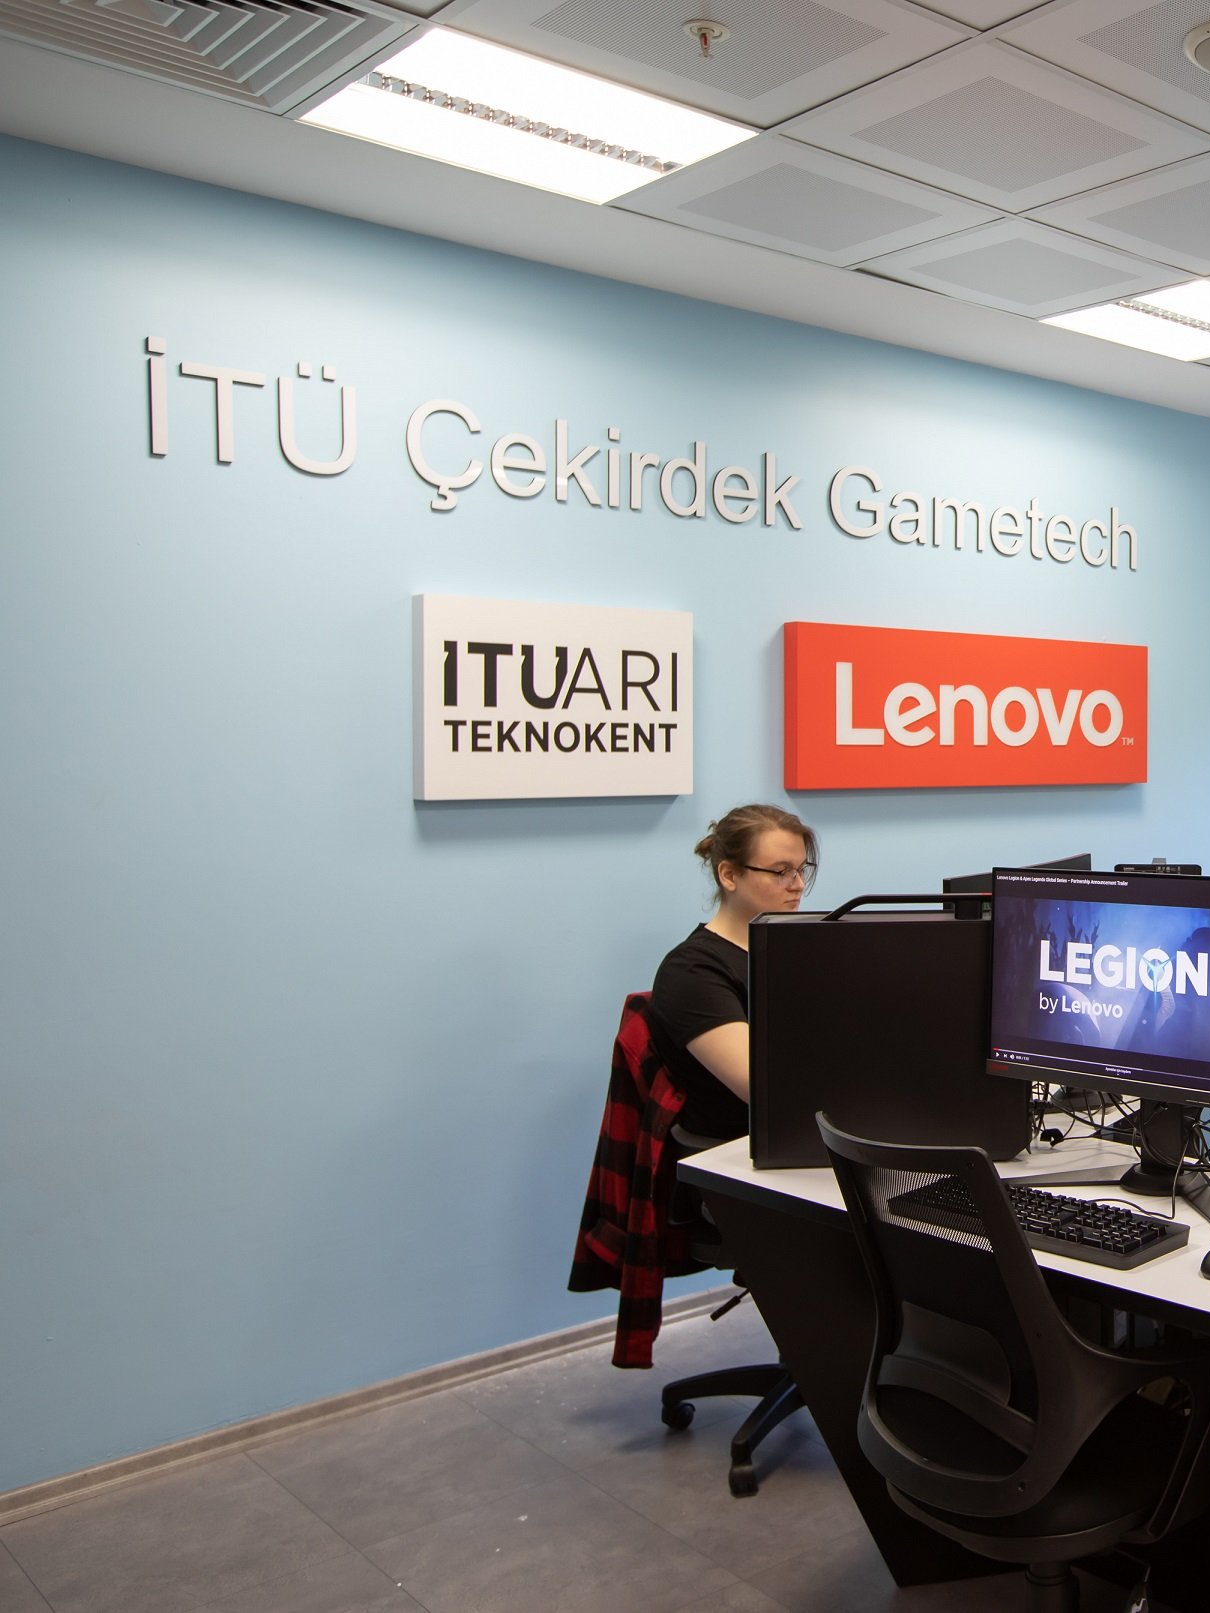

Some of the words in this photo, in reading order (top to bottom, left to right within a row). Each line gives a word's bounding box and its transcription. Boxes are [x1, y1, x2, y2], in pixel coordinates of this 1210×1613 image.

[144, 335, 357, 477] İTÜ
[405, 400, 803, 530] Çekirdek
[828, 464, 1138, 571] Gametech
[835, 661, 1124, 749] Lenovo
[443, 719, 678, 753] TEKNOKENT
[1039, 940, 1209, 997] LEGION
[1039, 992, 1059, 1014] by
[1061, 995, 1124, 1018] Lenovo
